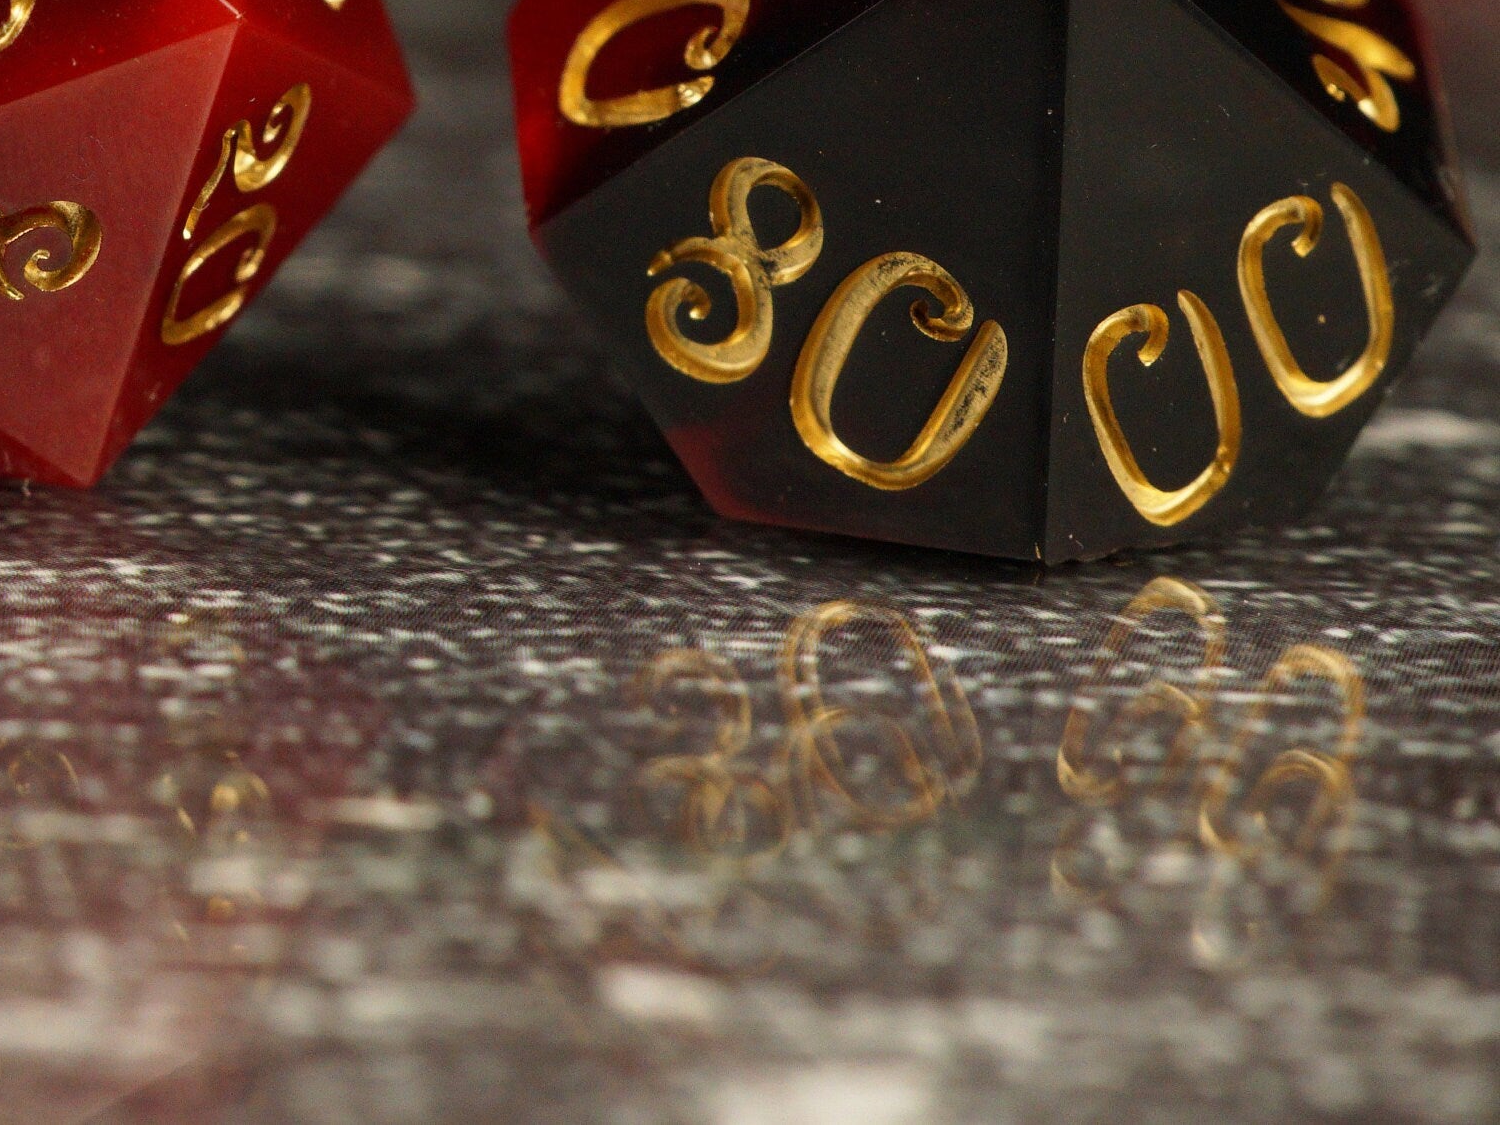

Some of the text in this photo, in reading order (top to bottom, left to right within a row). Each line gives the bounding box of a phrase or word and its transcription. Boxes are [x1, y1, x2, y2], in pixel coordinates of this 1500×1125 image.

[161, 82, 313, 348] 20
[644, 155, 1010, 492] 80
[1081, 181, 1396, 528] 00
